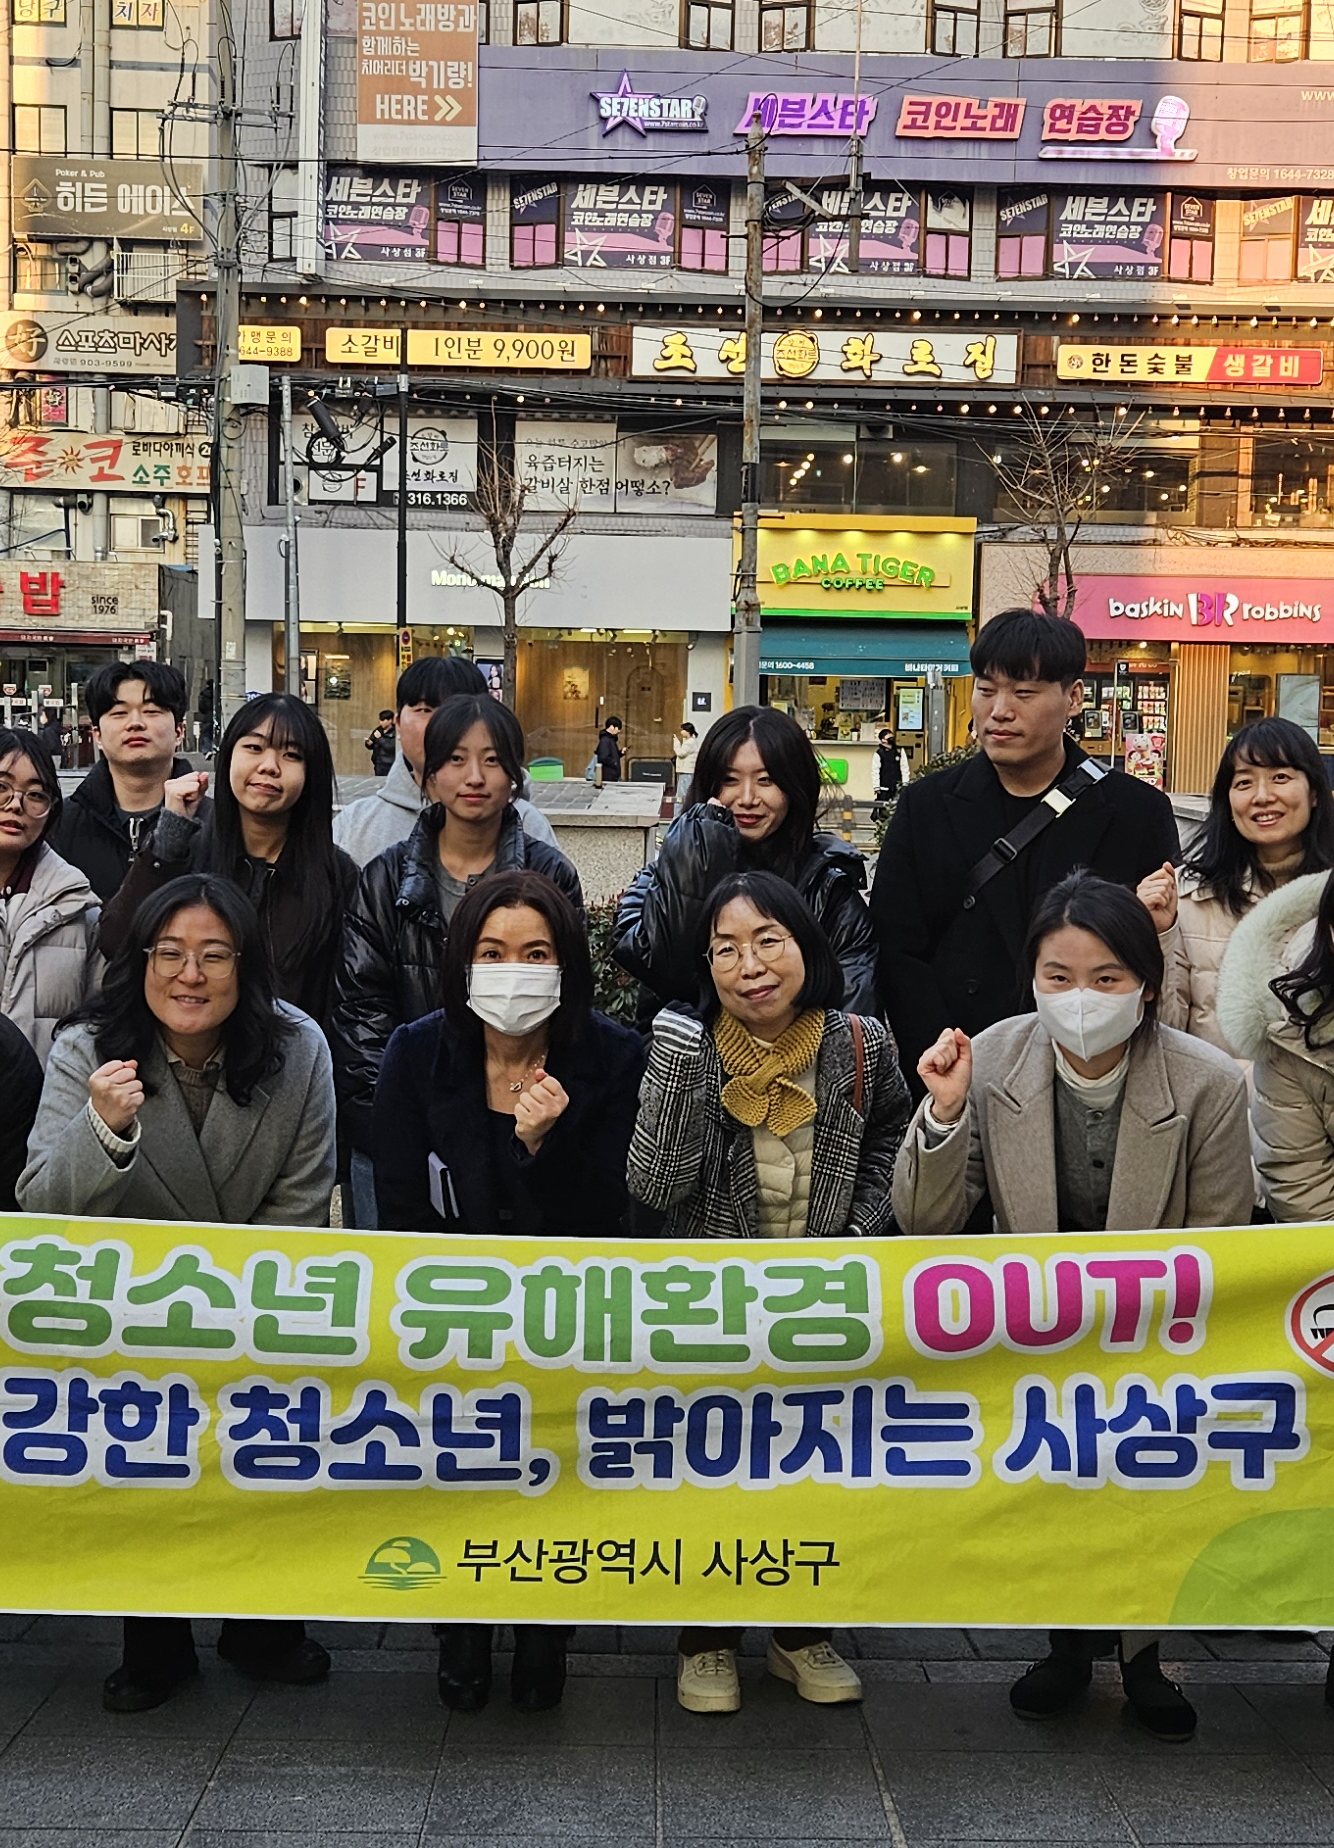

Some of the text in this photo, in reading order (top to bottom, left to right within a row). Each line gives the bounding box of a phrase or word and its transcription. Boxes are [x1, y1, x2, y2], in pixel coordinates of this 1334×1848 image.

[362, 36, 420, 57] 함께하는
[362, 59, 473, 89] 치어리더 박기량!
[376, 94, 429, 121] HERE
[902, 100, 1020, 133] 코인노래
[1048, 103, 1136, 135] 연습장
[55, 168, 79, 178] Poker
[90, 168, 106, 178] Pub
[1227, 167, 1270, 180] 창업문의
[56, 180, 196, 217] 히든 에이스
[325, 176, 422, 204] 세븐스타
[571, 183, 668, 211] 세븐스타
[1059, 195, 1157, 222] 세븐스타
[180, 223, 195, 235] 4F
[340, 334, 576, 363] 소갈비 1인분 9,900원
[841, 333, 997, 380] 화로집
[80, 358, 133, 368] 903-9599
[1091, 352, 1299, 378] 한돈숯불 생갈비
[132, 464, 171, 488] 소주
[524, 454, 606, 473] 육즙터지는
[407, 492, 468, 506] 316.1366
[524, 477, 671, 496] 갈비살 한점 어떻소?
[771, 552, 936, 589] BANA TIGER
[820, 576, 885, 590] COFFEE
[91, 594, 119, 605] since
[93, 604, 118, 615] 1976
[1108, 592, 1322, 627] baskin BR robbins
[775, 661, 815, 670] 1600-4458
[0, 1239, 1204, 1367] 청소년 유해환경 OUT!
[228, 1383, 552, 1488] 청소년,
[586, 1382, 974, 1482] 밝아지는
[1003, 1379, 1302, 1482] 사상구
[456, 1536, 842, 1587] 부산광역시 사상구
